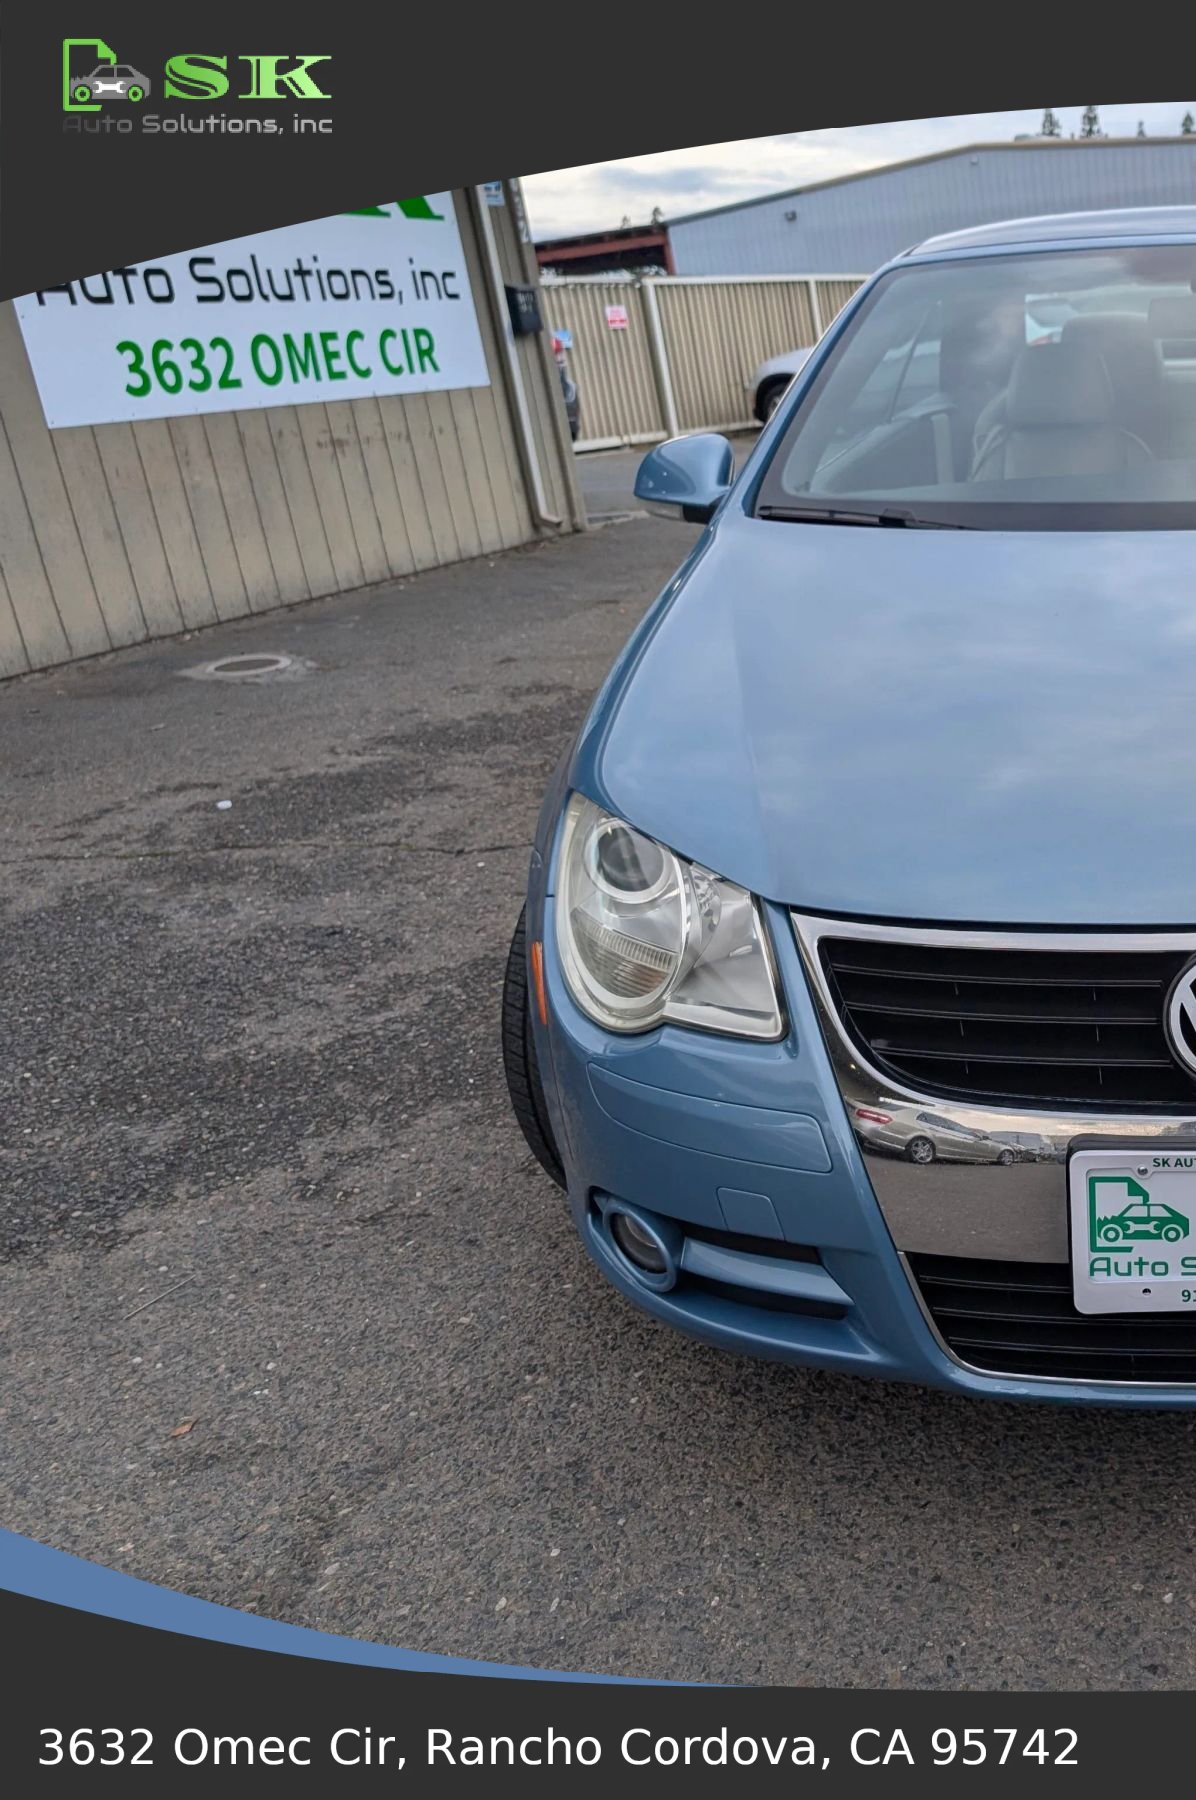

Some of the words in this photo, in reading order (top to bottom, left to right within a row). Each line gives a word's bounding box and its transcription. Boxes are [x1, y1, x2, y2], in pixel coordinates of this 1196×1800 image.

[188, 253, 403, 305] Solutions,
[410, 260, 460, 301] inc
[116, 337, 242, 397] 3632
[250, 329, 372, 386] OMEC
[379, 327, 440, 375] CIR
[1152, 1157, 1171, 1168] SK
[1089, 1256, 1170, 1277] Auto
